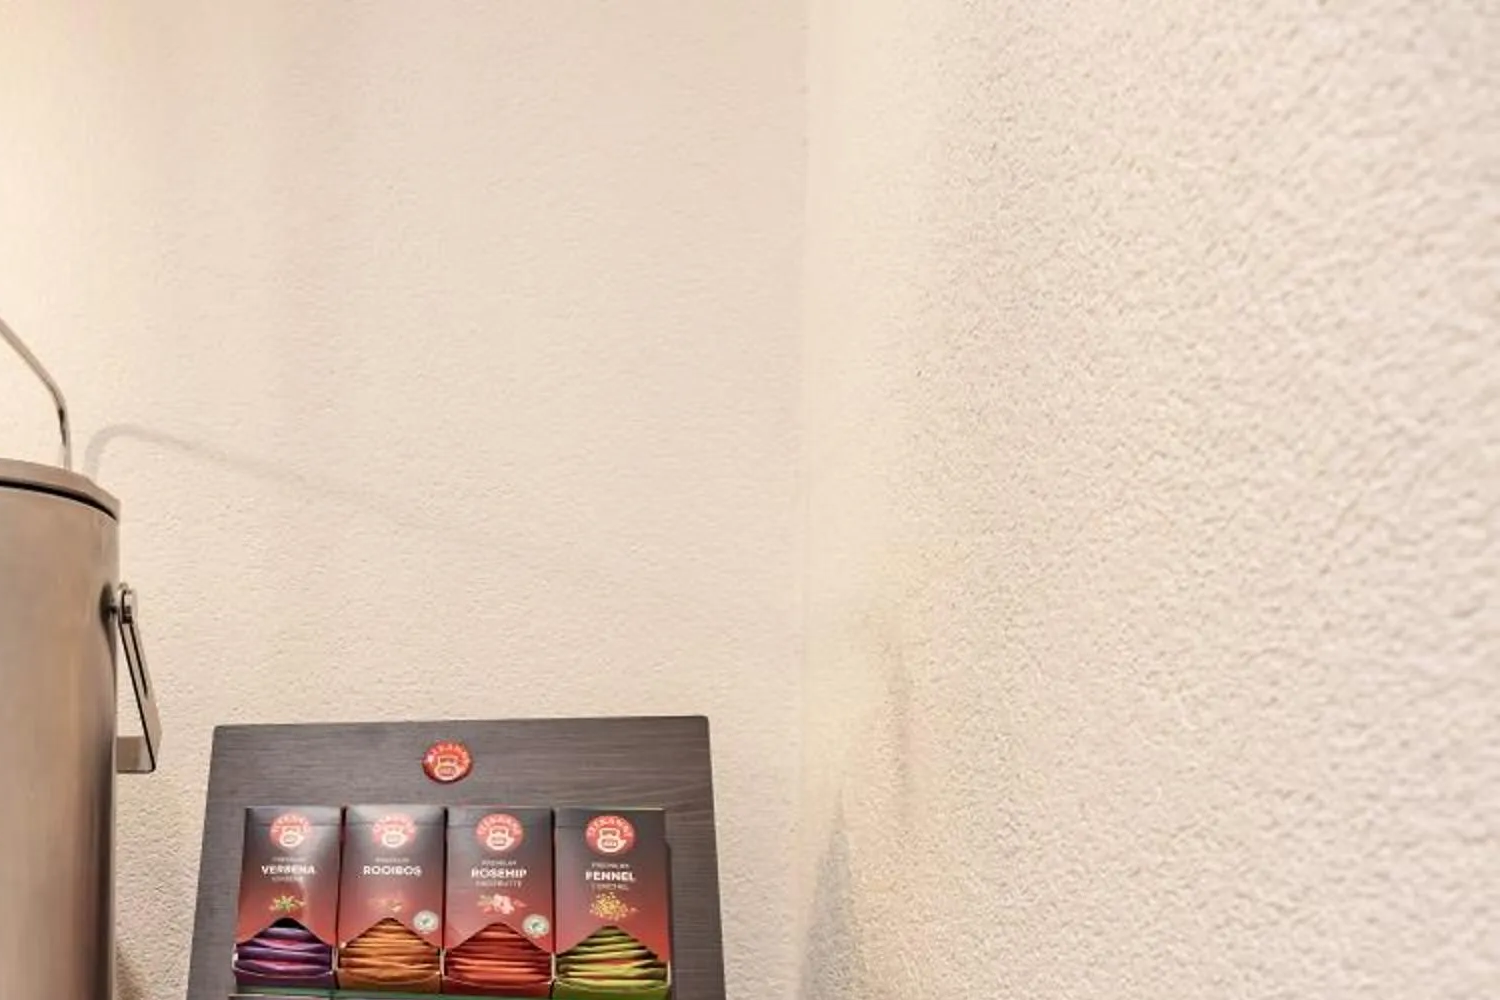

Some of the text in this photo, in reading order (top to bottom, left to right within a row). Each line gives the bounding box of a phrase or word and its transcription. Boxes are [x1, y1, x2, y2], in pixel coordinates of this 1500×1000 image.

[261, 865, 315, 875] VERBENA
[362, 865, 422, 876] ROOIBOS
[471, 867, 527, 879] ROSEHIP
[585, 871, 636, 882] FENNEL
